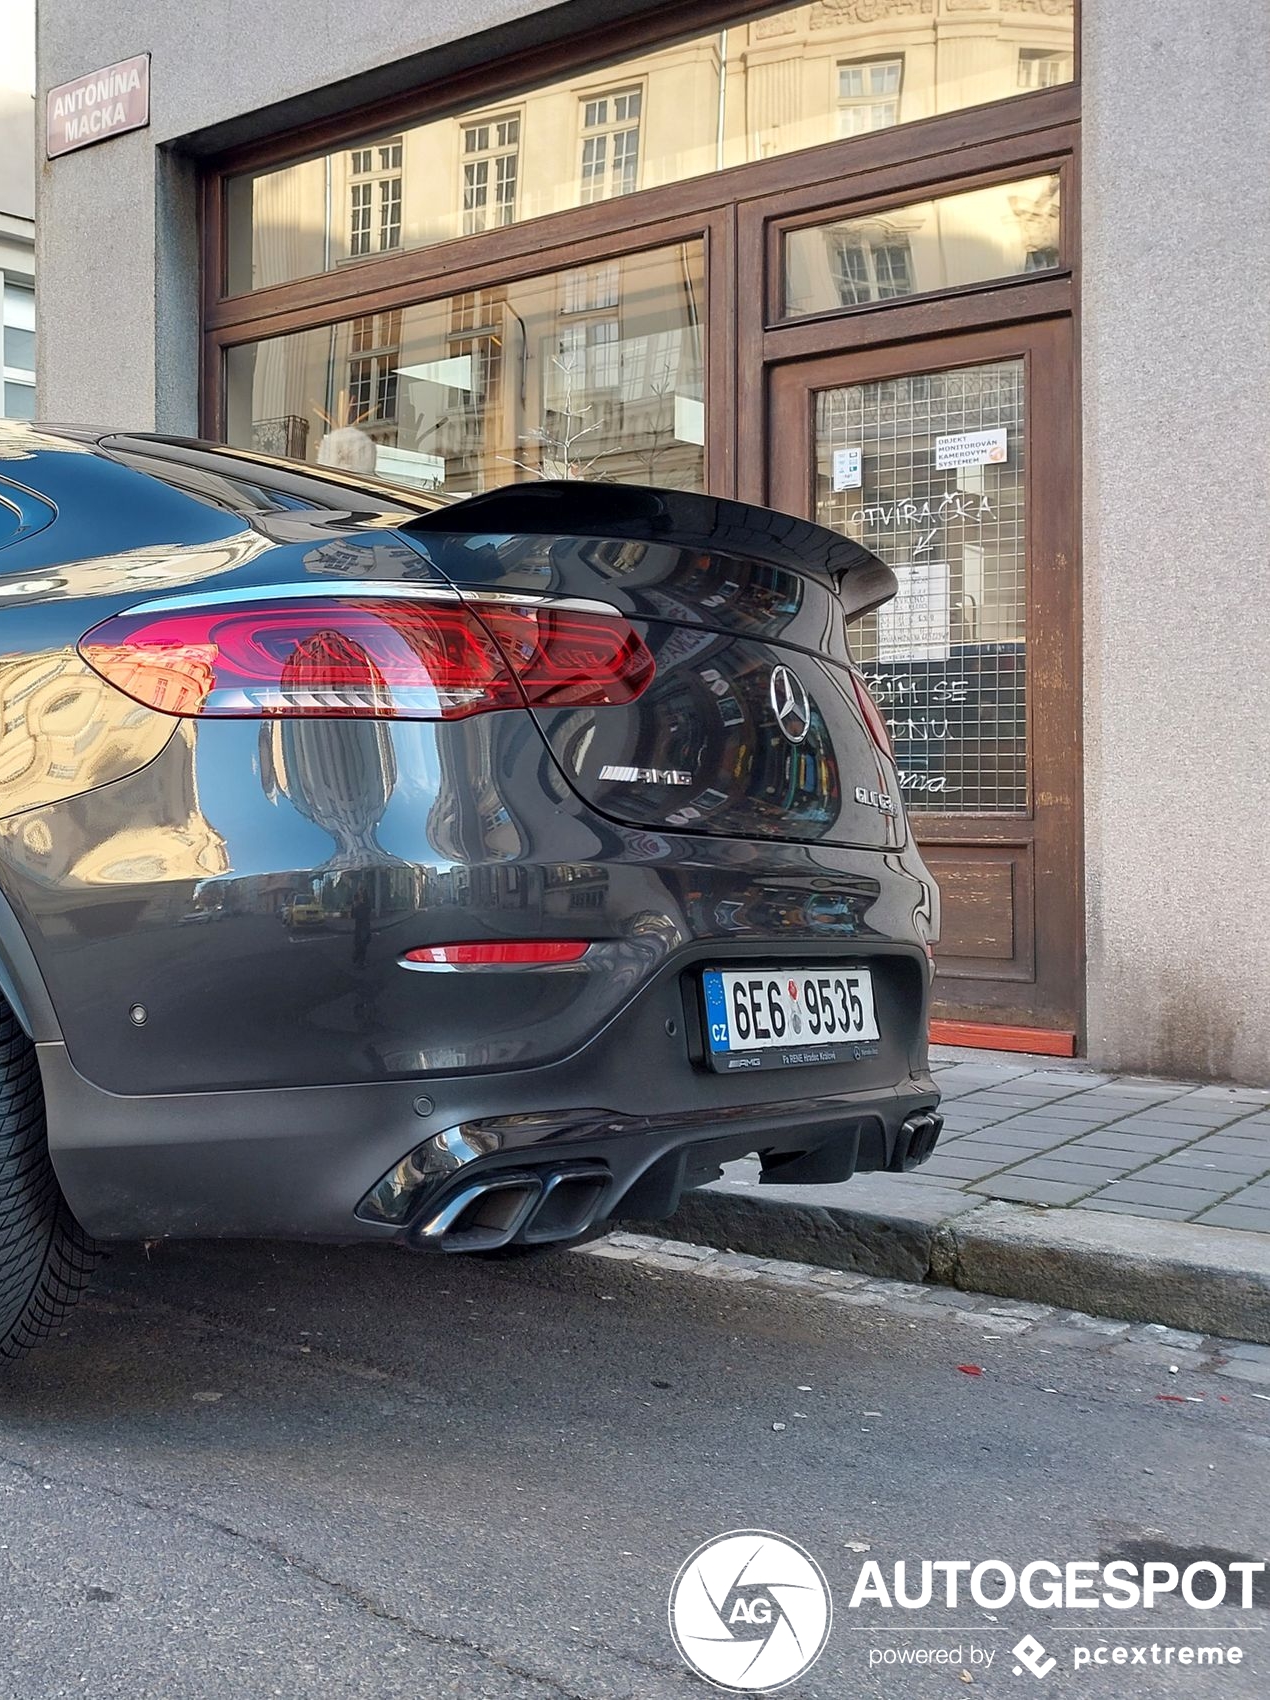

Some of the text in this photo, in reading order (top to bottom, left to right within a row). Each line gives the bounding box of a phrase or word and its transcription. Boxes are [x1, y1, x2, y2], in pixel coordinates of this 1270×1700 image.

[53, 69, 141, 120] ANTONÍNA
[65, 102, 126, 143] MACKA
[938, 436, 966, 445] OBJEKT
[933, 681, 969, 702] SE
[636, 766, 692, 785] AMG
[733, 978, 864, 1040] 6E6 9535
[712, 1024, 728, 1042] CZ
